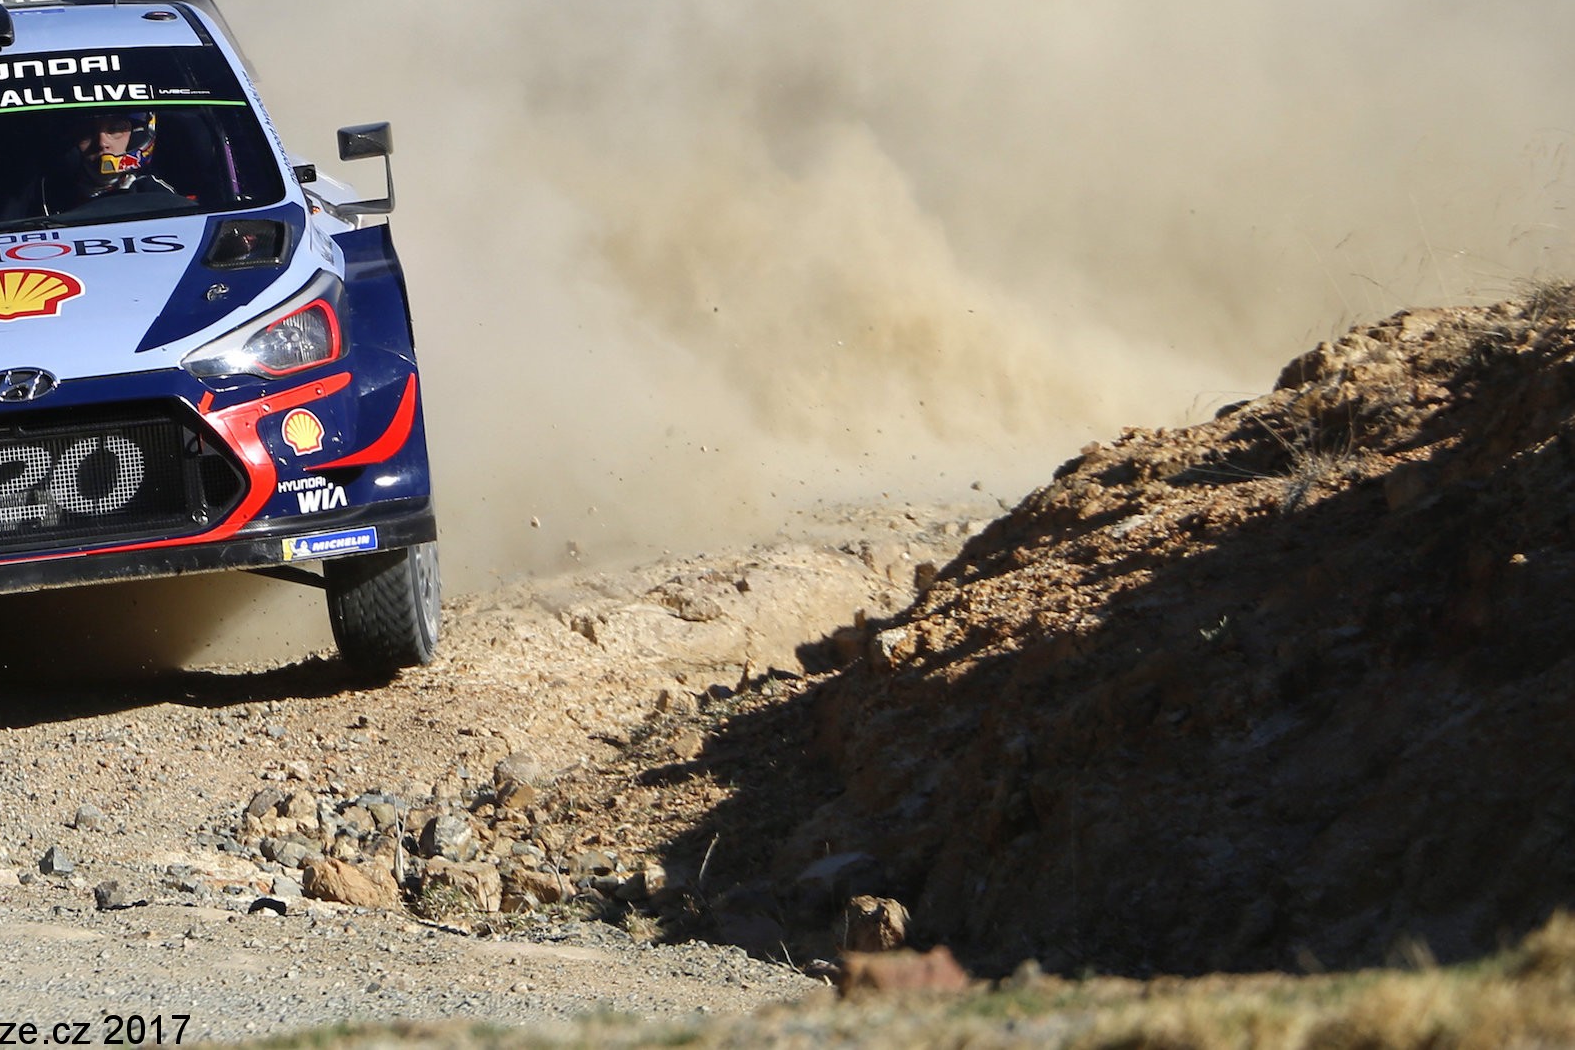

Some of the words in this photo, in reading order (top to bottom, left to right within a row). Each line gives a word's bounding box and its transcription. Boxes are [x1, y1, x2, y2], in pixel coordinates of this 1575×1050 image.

[0, 86, 65, 107] ALL
[73, 84, 149, 102] LIVE
[278, 475, 327, 493] HYUNDAI
[311, 534, 371, 552] MICHELIN
